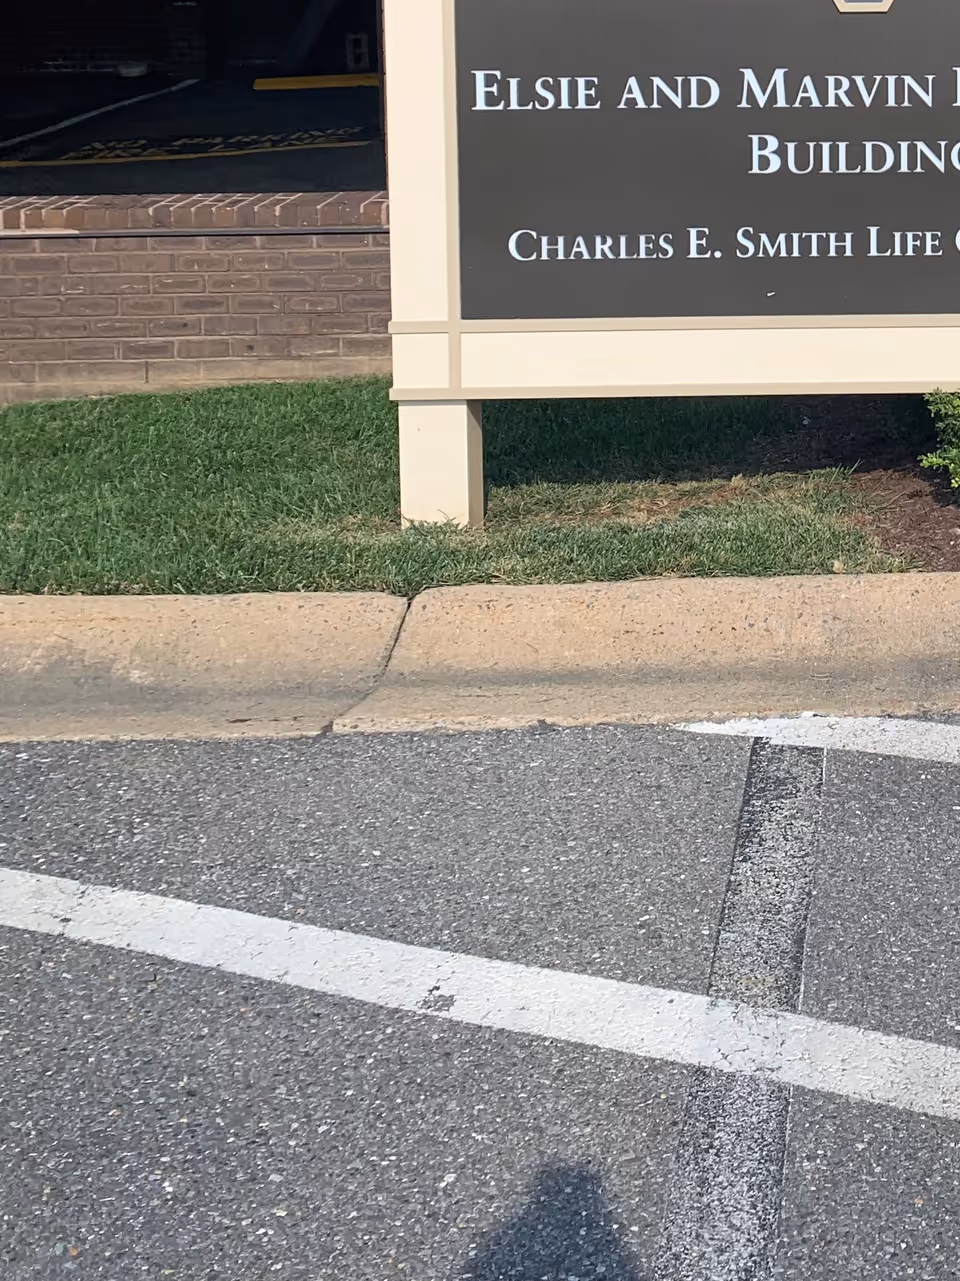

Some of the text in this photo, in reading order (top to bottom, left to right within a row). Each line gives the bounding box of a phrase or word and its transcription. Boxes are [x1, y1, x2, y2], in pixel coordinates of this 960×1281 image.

[470, 69, 601, 111] ELSIE
[616, 75, 721, 110] AND
[736, 67, 937, 109] MARVIN
[507, 229, 674, 261] CHARLES
[685, 227, 722, 259] E.
[735, 226, 855, 258] SMITH
[866, 225, 943, 257] LIFE
